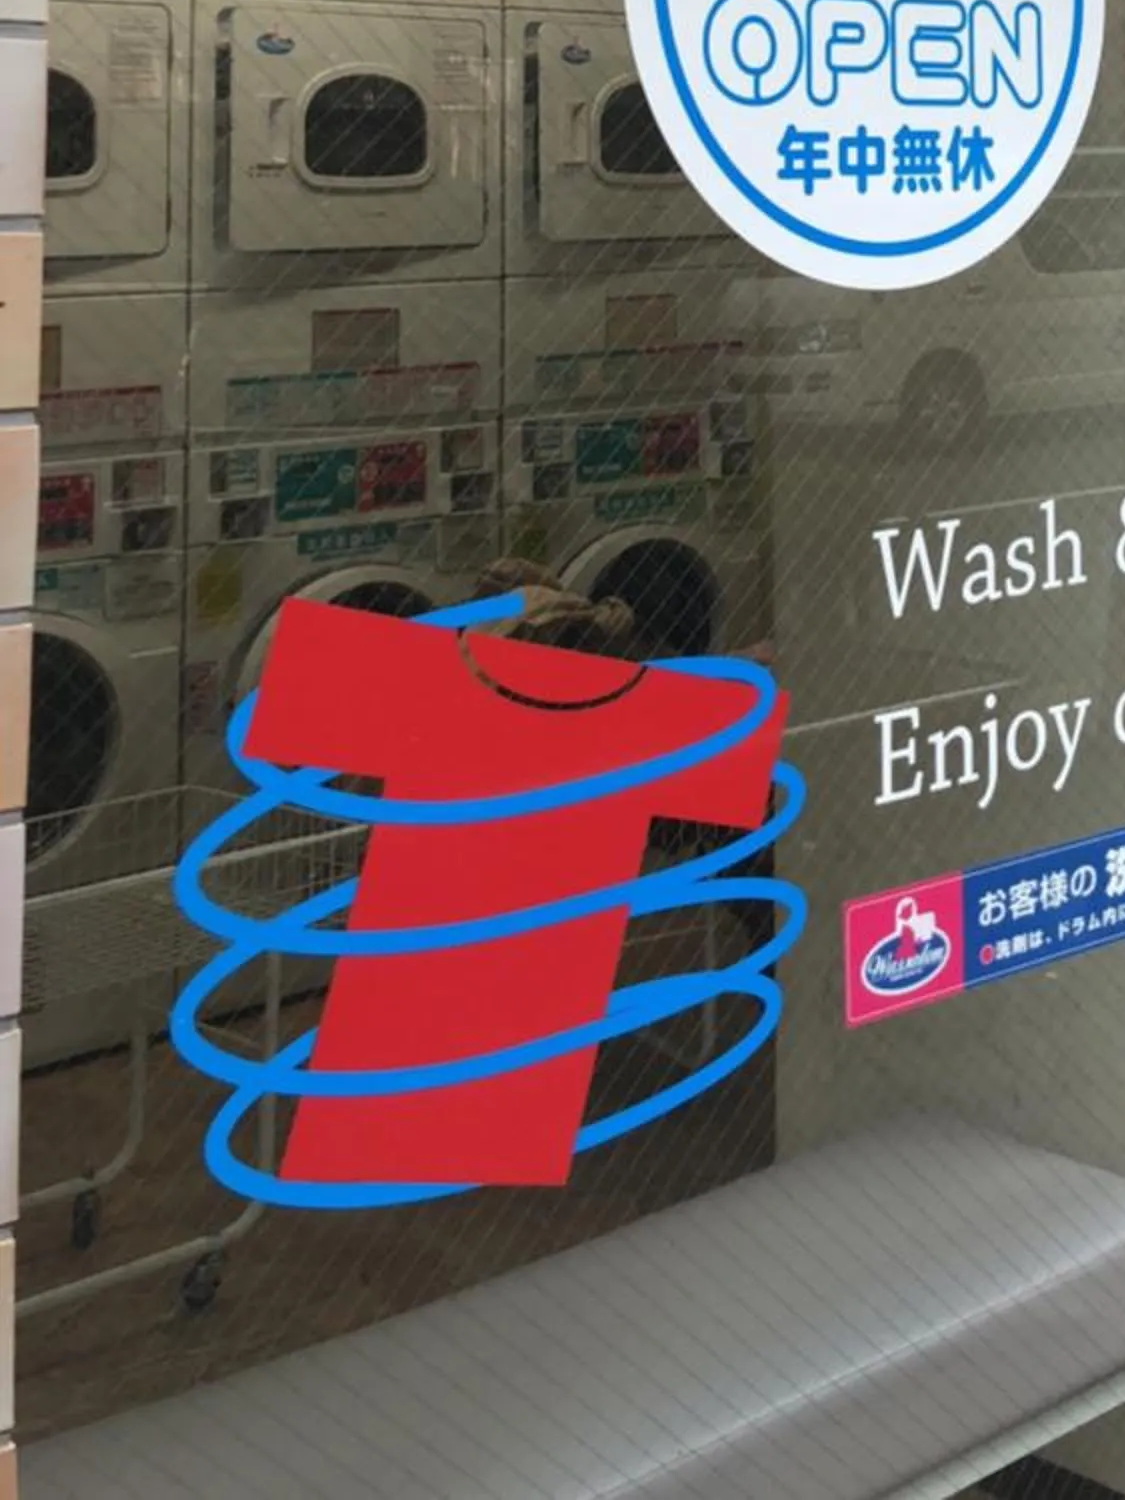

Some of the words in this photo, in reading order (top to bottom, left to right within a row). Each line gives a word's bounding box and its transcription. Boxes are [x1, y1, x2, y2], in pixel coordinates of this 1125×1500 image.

[776, 124, 996, 196] 年中無休
[872, 500, 1087, 620] Wash
[873, 692, 1092, 809] Enjoy
